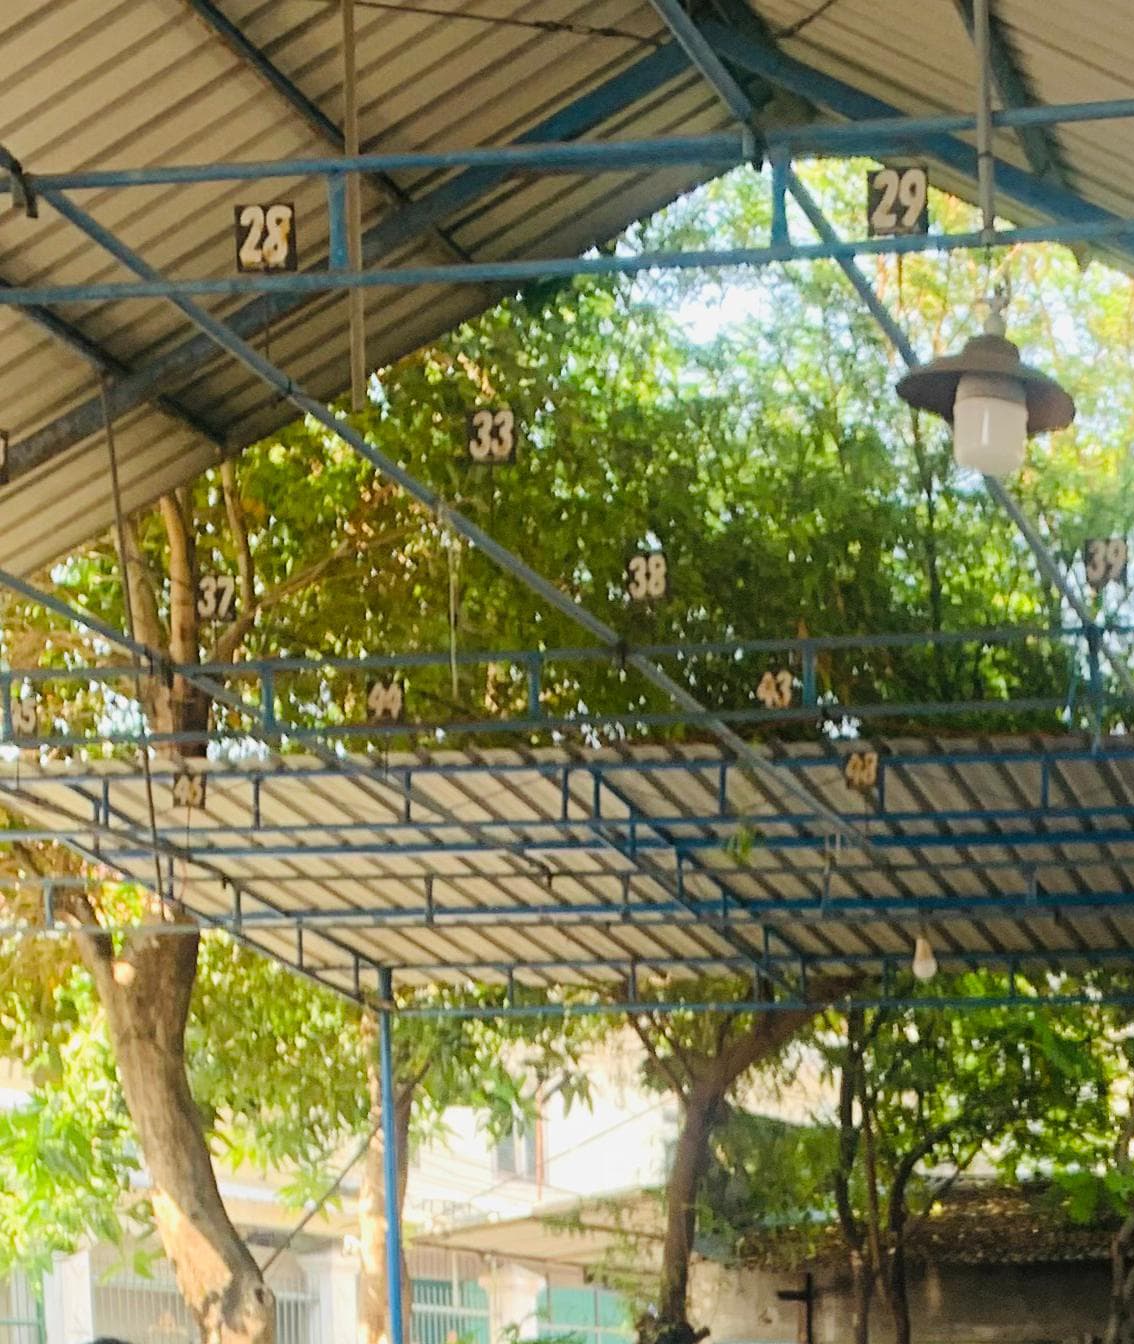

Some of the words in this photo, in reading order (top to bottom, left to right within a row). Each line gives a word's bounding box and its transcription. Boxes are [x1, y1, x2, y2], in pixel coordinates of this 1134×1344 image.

[870, 168, 927, 229] 29
[239, 204, 292, 265] 28
[469, 410, 514, 460] 33
[629, 554, 667, 599] 38
[1088, 539, 1126, 584] 39
[198, 576, 235, 619] 37
[368, 682, 403, 719] 44
[757, 669, 793, 709] 43
